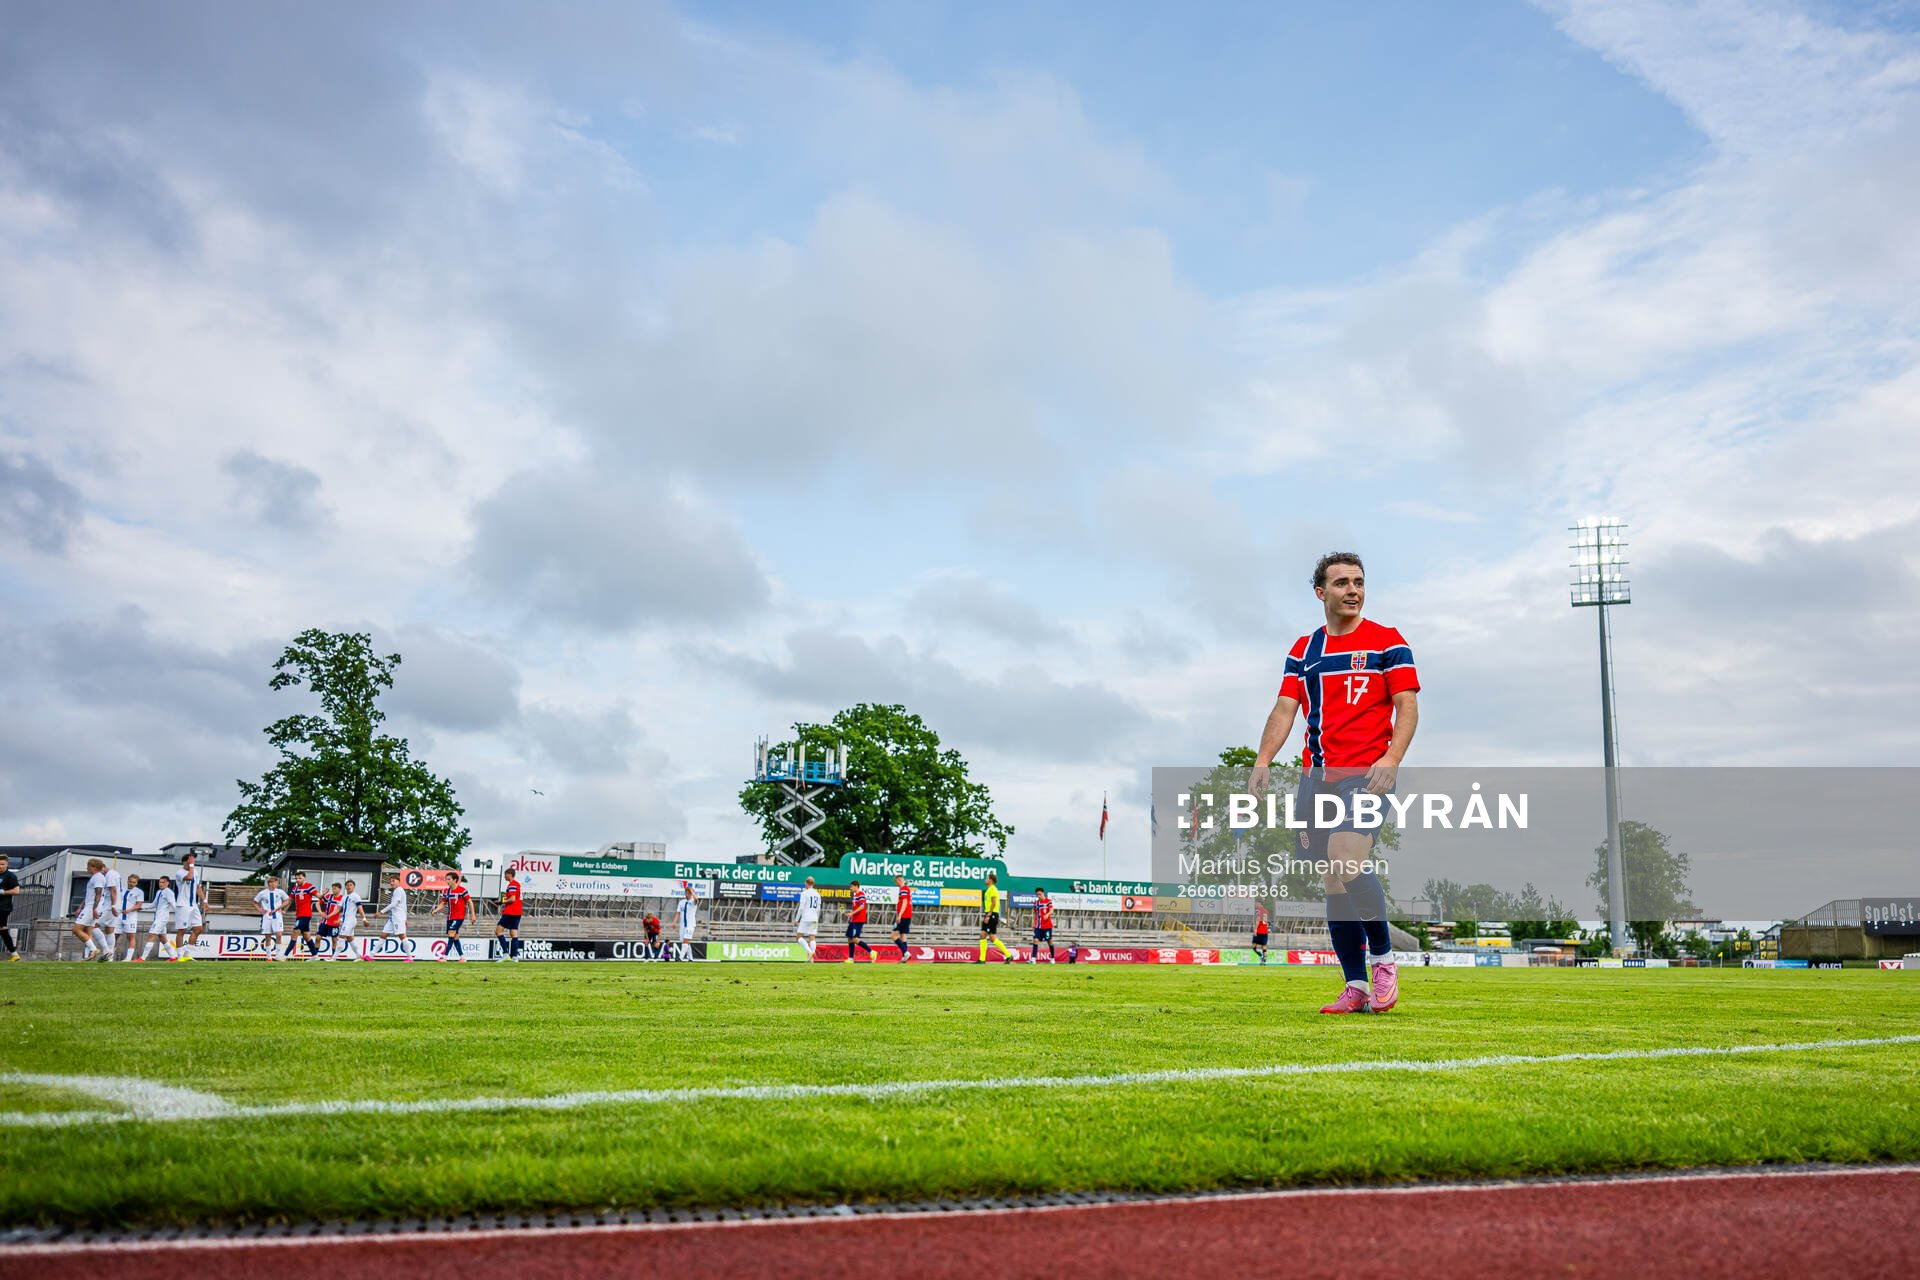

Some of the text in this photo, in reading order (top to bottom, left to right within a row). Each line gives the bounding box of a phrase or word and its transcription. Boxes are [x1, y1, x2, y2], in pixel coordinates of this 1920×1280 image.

[1344, 676, 1369, 705] 17
[602, 862, 627, 871] Eidsberg
[675, 864, 693, 877] En
[732, 866, 755, 880] der
[758, 867, 775, 880] du
[777, 870, 792, 881] er
[850, 857, 997, 880] Marker & Eidsberg
[570, 880, 610, 890] eurofins
[1089, 881, 1113, 894] bank
[1115, 882, 1132, 895] der
[1134, 883, 1146, 895] du
[1148, 886, 1158, 895] er
[227, 936, 276, 952] BDO
[739, 944, 789, 960] unisport
[938, 951, 971, 960] VIKING
[1023, 951, 1051, 960] VIING
[1103, 952, 1132, 961] VIKING
